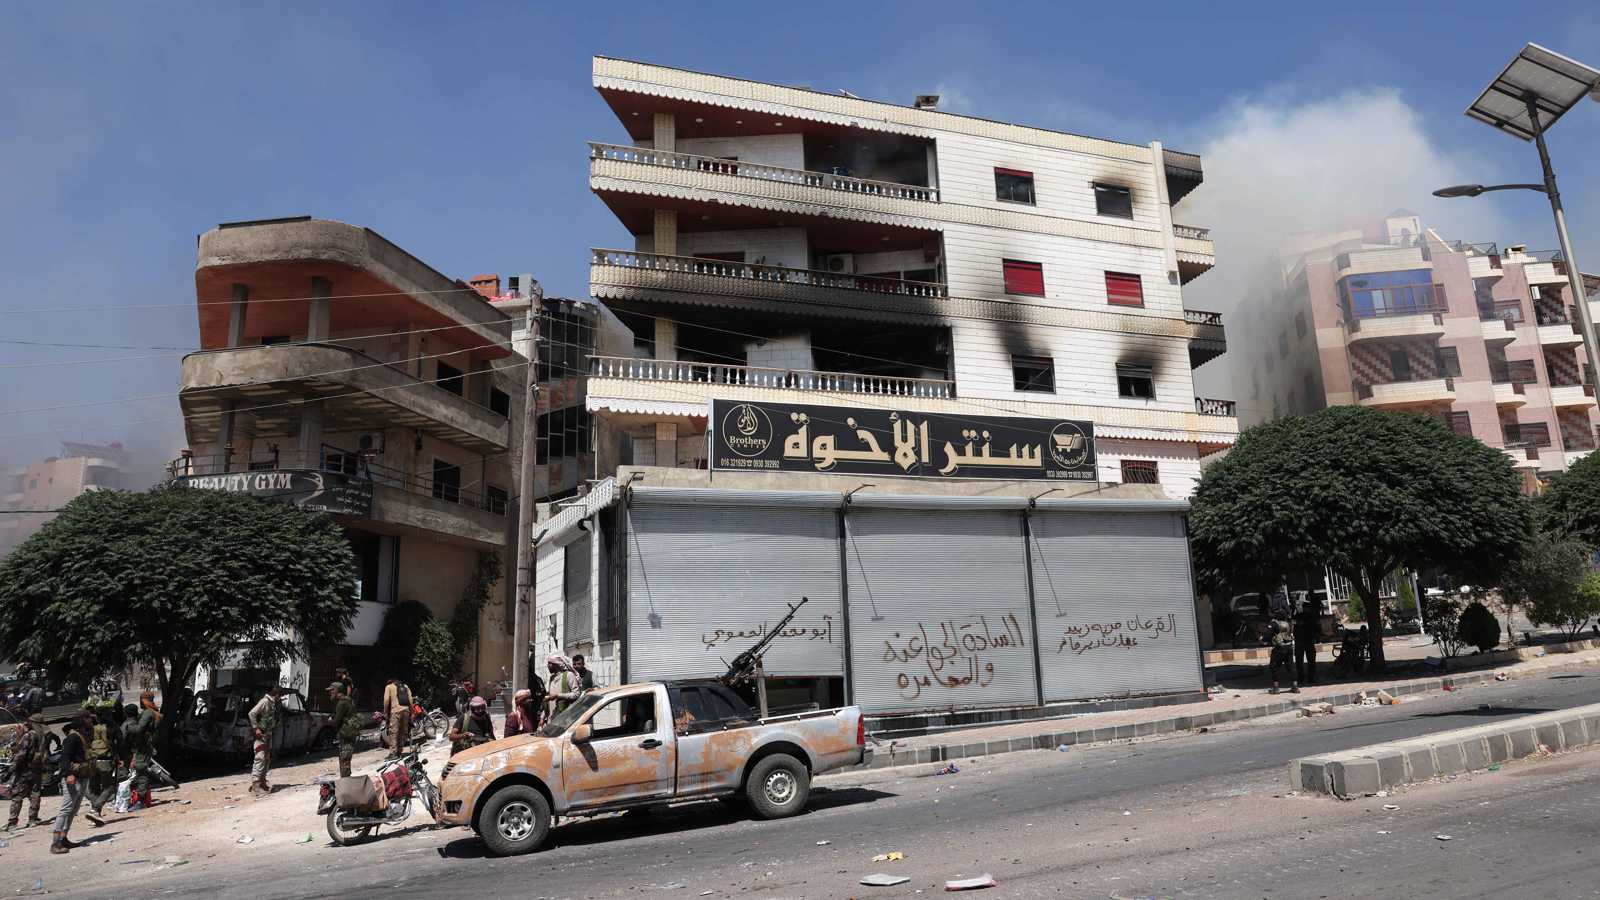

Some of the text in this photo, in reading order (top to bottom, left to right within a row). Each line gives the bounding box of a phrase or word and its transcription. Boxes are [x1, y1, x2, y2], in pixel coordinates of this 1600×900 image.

[729, 435, 767, 445] Brothers
[938, 428, 1045, 476] سنتر
[254, 473, 293, 490] GYM
